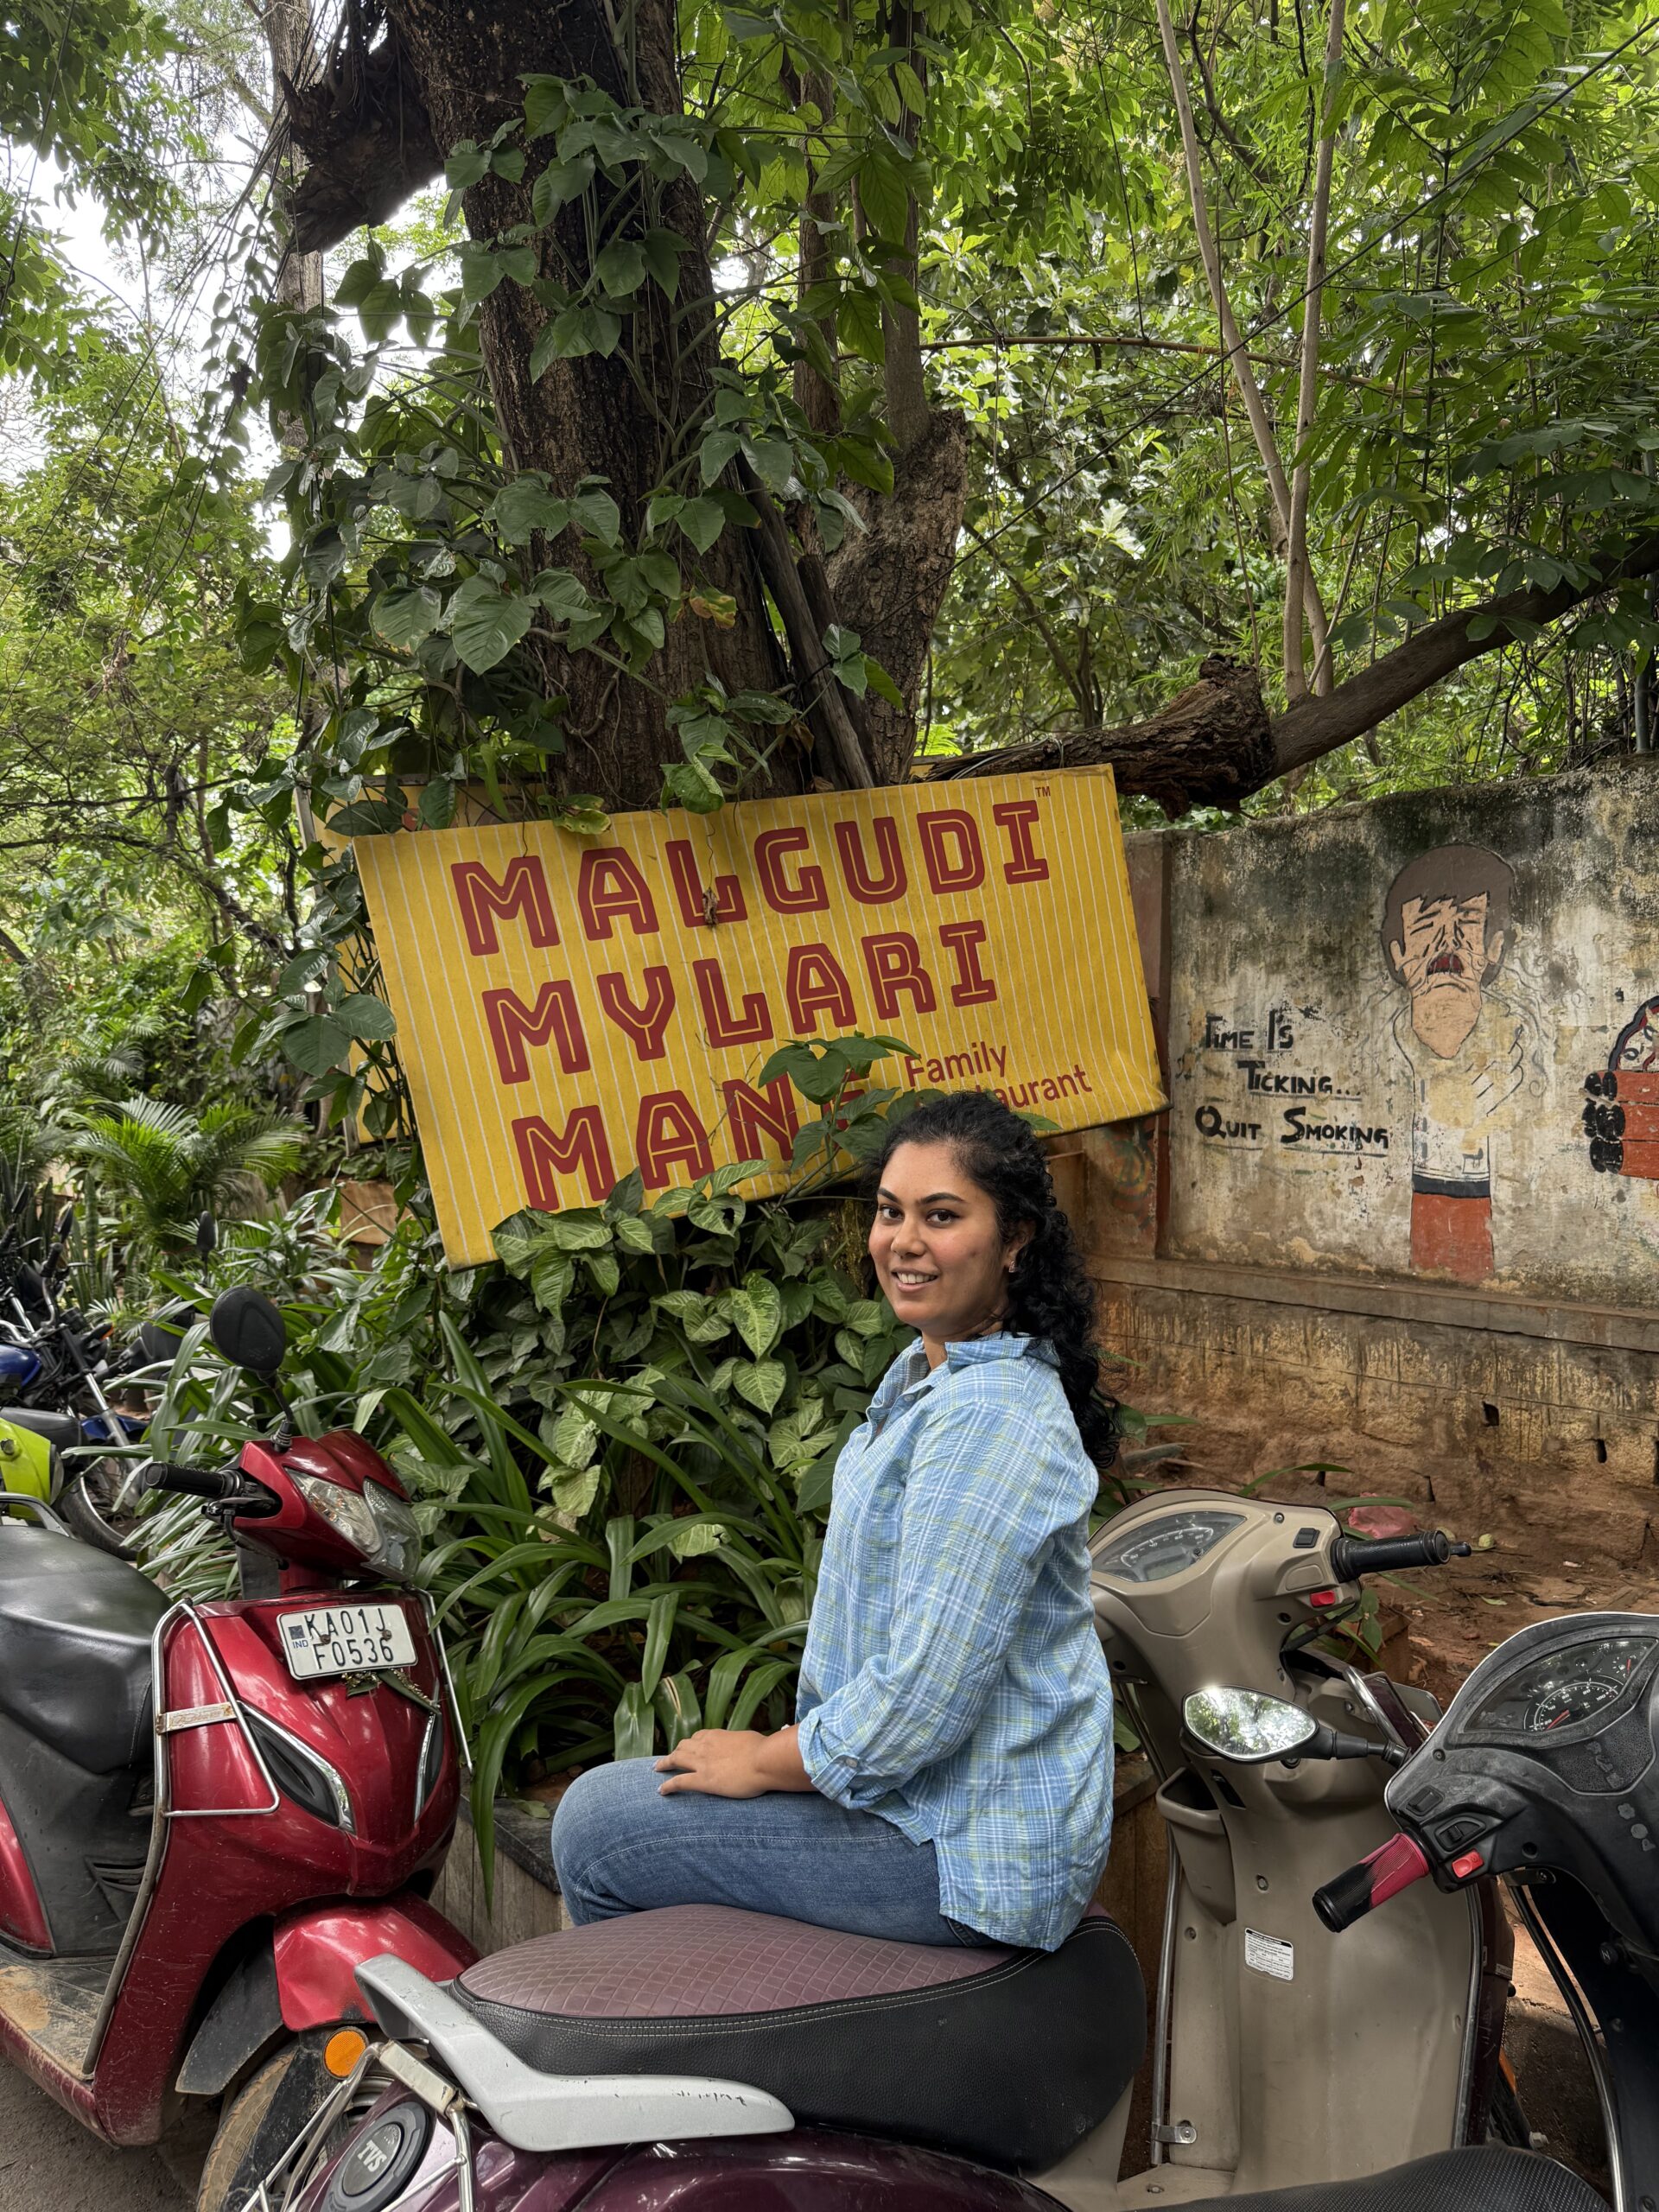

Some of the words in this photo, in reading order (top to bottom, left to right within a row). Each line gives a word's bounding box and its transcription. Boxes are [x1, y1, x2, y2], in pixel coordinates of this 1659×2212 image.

[450, 799, 1050, 956] MALGUDI
[481, 919, 997, 1084] MYLARI
[904, 1040, 1007, 1088] Family
[292, 1639, 308, 1649] IND
[312, 1638, 394, 1670] F0536
[357, 2139, 388, 2172] TVS
